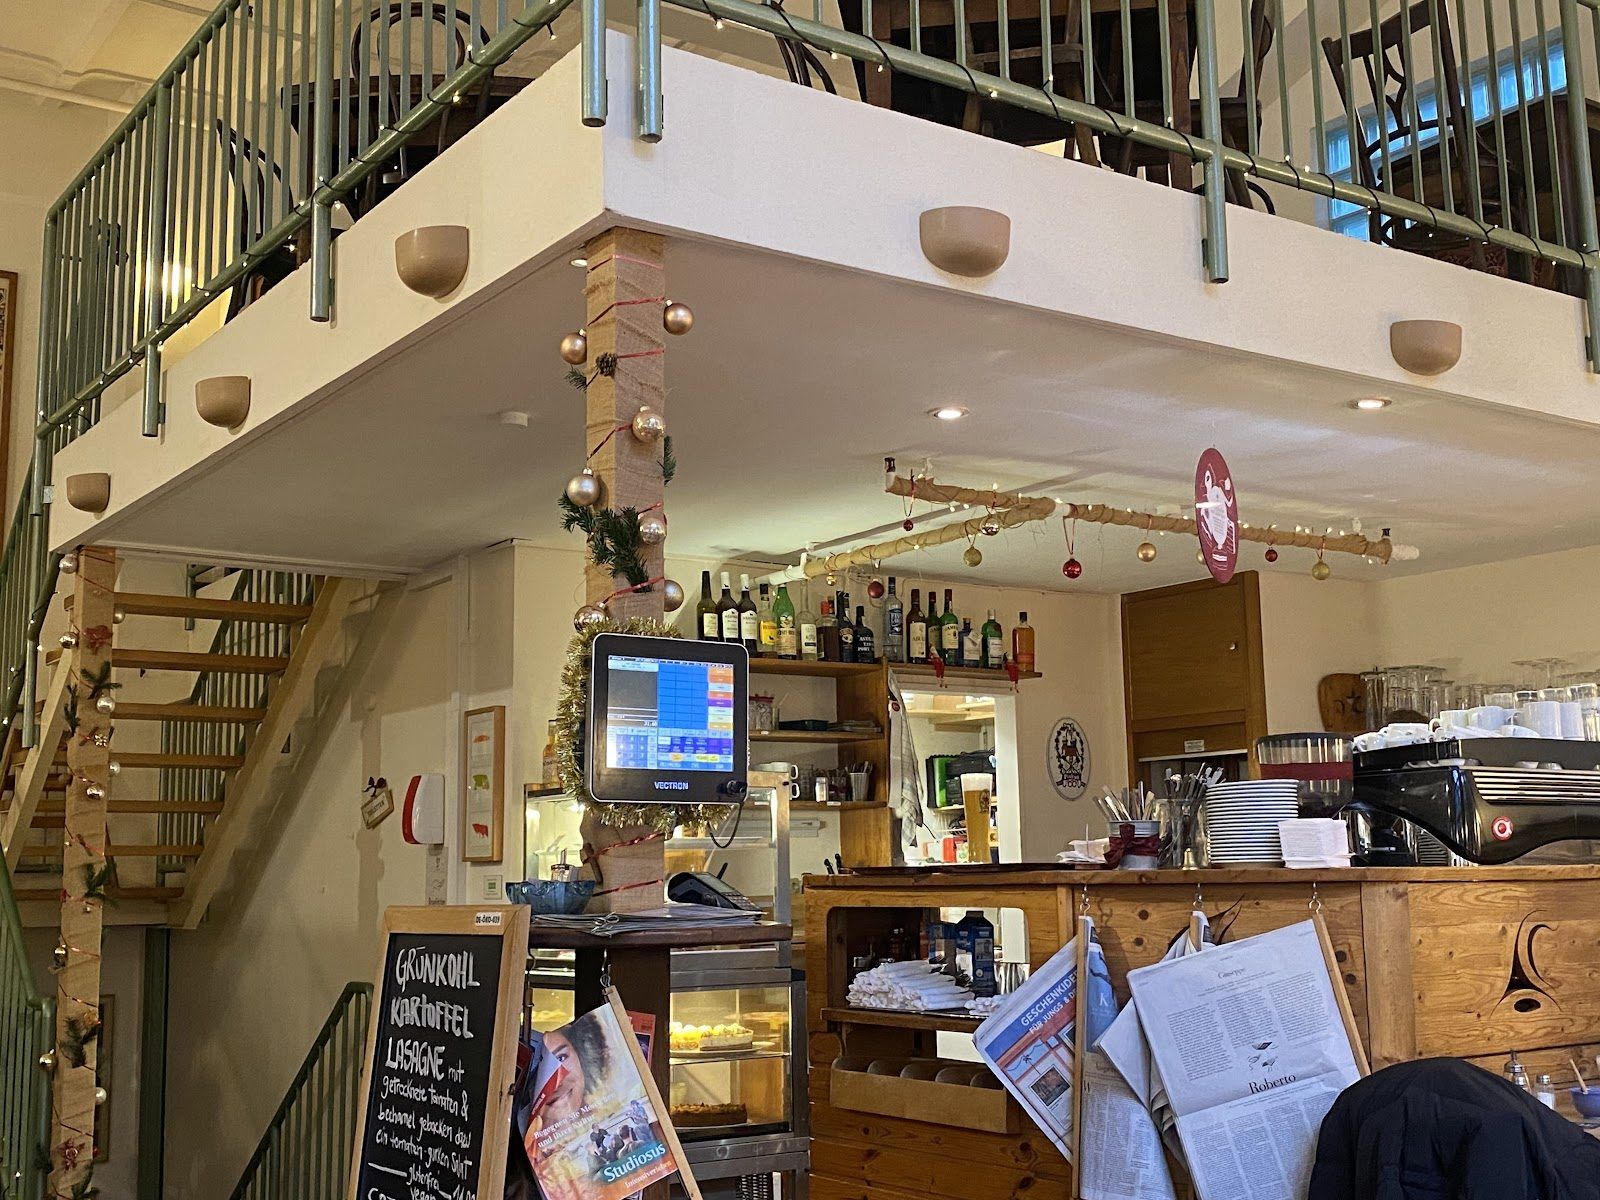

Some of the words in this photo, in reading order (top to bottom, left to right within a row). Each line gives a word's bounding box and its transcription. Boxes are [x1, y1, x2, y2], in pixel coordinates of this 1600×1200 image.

[654, 781, 689, 790] VECTRON
[1029, 1022, 1043, 1034] FÜR
[1043, 1003, 1064, 1023] JUNGS
[385, 1037, 445, 1081] LASAGNE
[448, 1059, 465, 1083] mit
[1249, 1074, 1296, 1094] Roberto
[460, 1090, 469, 1122] &
[538, 1135, 553, 1148] und
[603, 1143, 666, 1182] Studiosus
